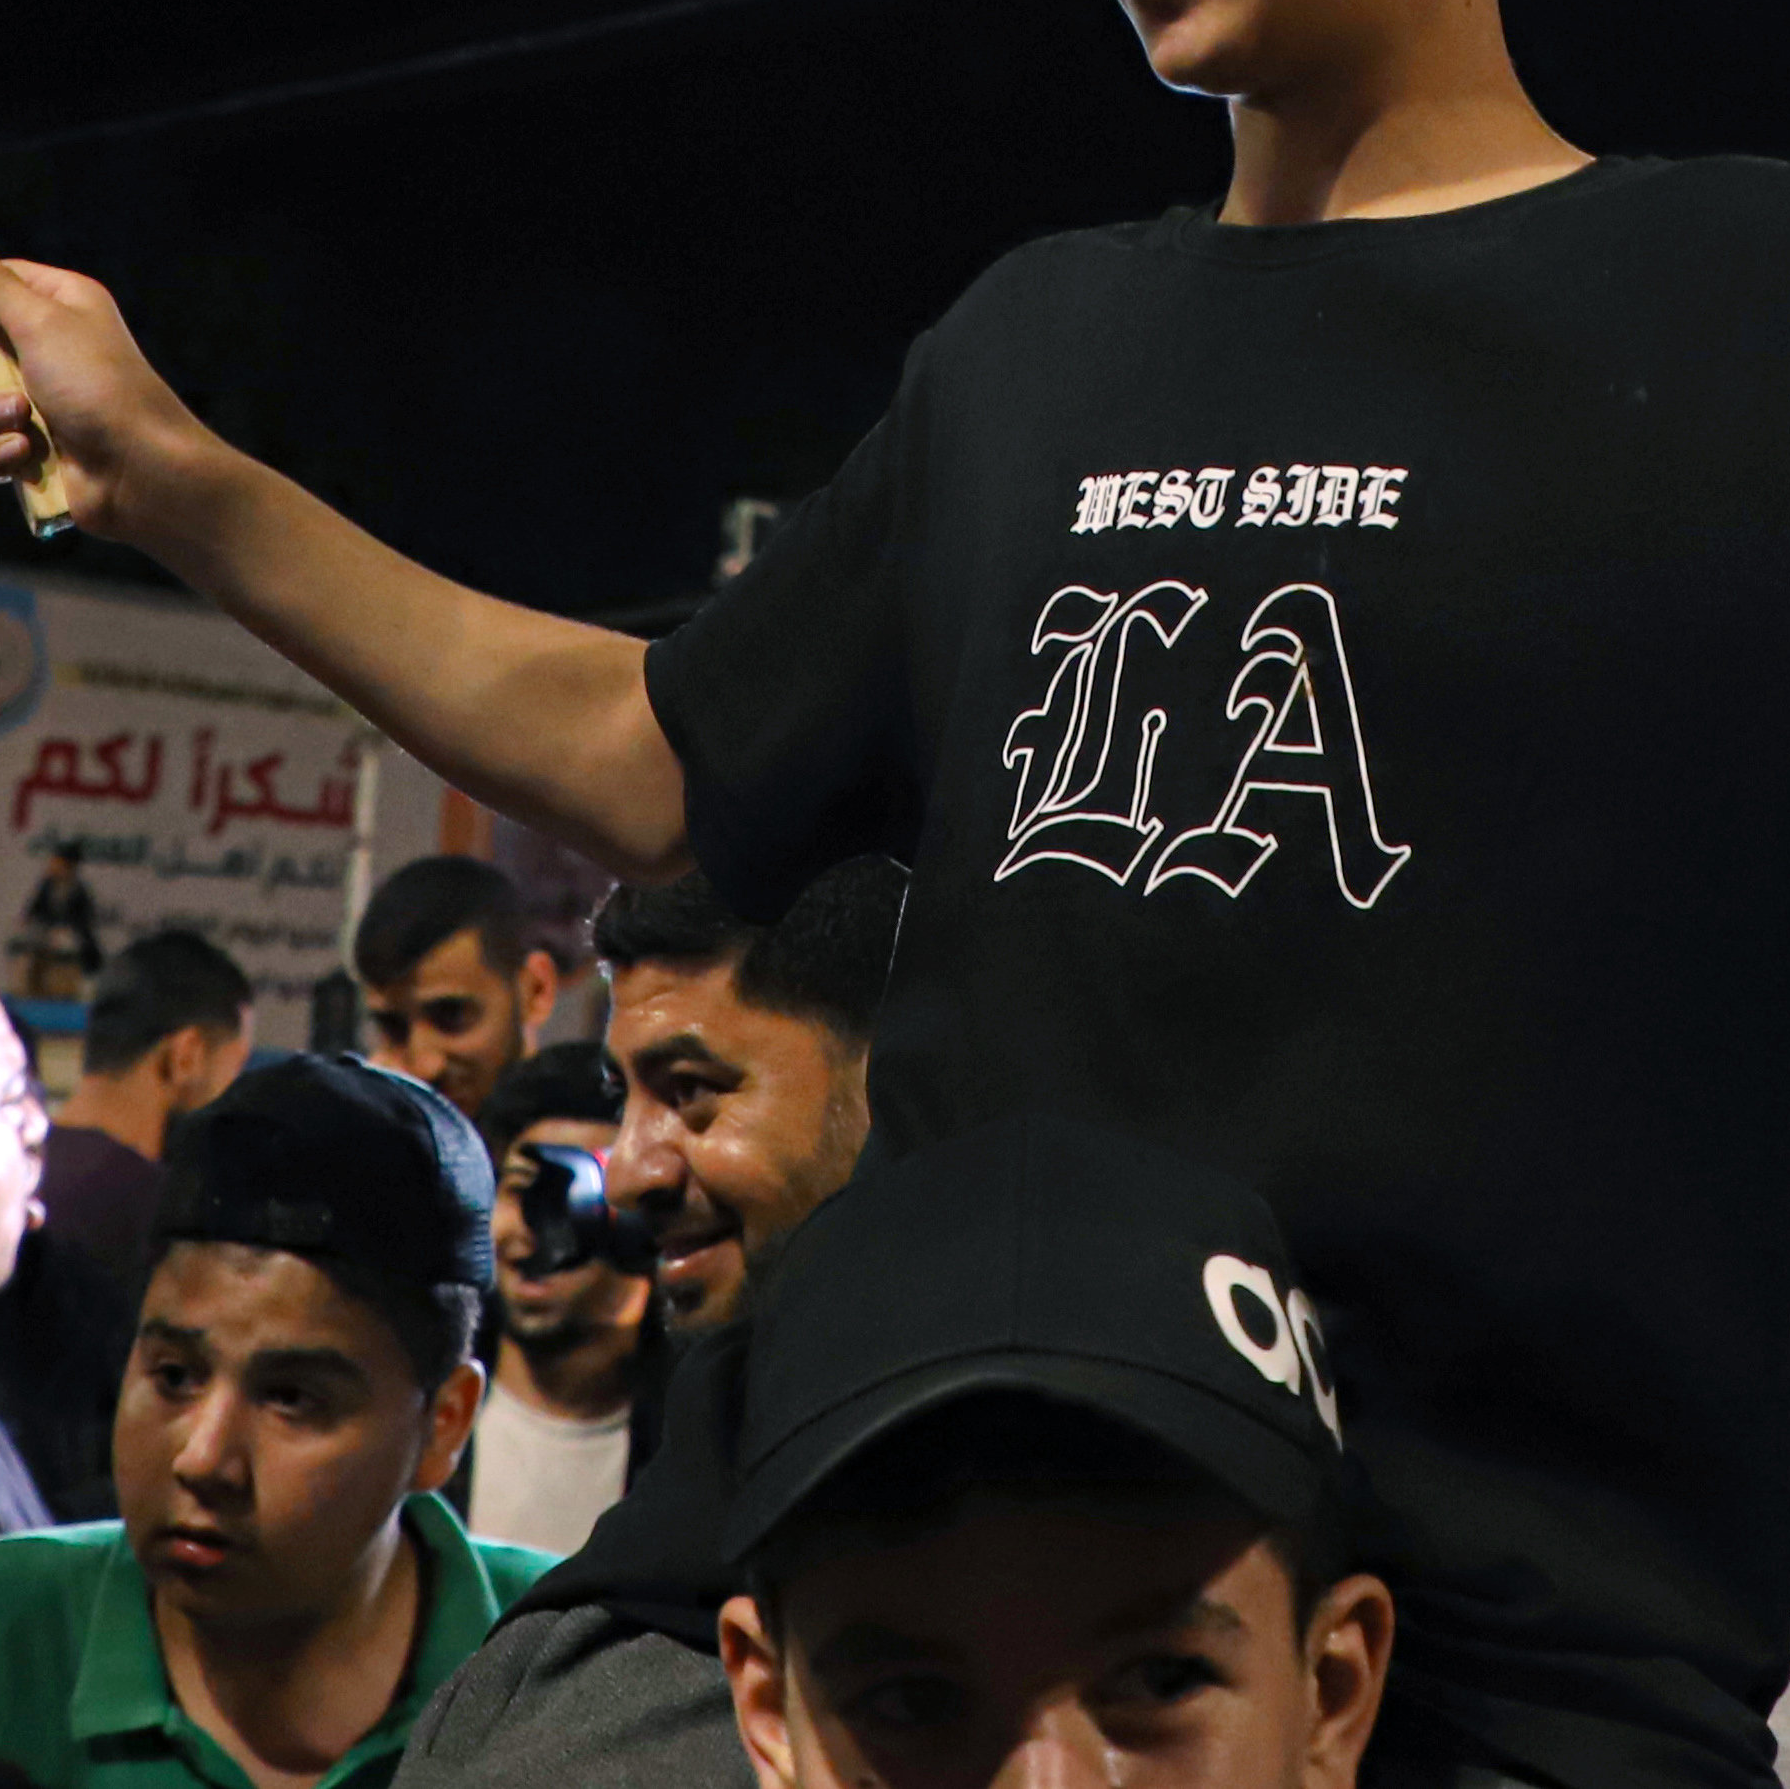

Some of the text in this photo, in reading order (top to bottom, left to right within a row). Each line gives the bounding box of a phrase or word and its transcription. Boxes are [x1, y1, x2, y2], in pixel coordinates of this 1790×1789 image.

[1069, 463, 1409, 535] WEST SIDE
[11, 728, 164, 832] لكم
[993, 579, 1412, 908] LA
